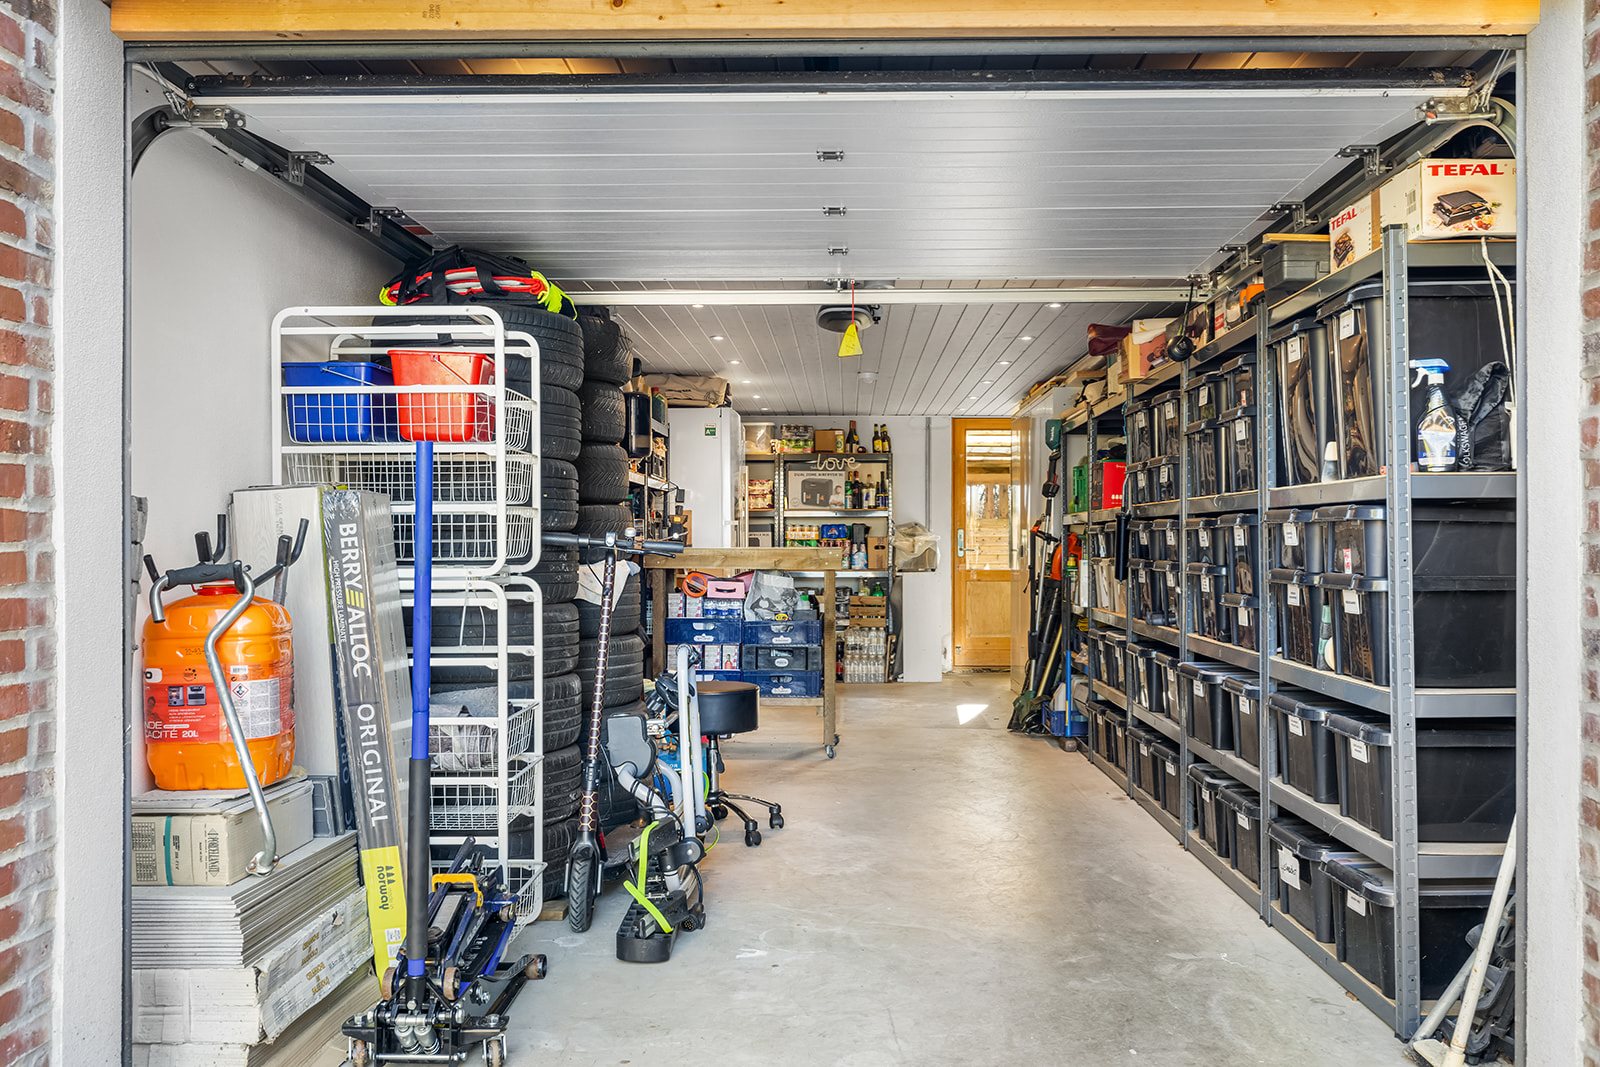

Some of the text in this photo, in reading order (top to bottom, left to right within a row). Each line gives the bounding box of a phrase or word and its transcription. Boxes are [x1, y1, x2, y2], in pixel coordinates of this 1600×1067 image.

[1427, 163, 1504, 176] TEFAL
[1331, 207, 1358, 231] TEFAL
[817, 453, 861, 470] love
[333, 560, 347, 642] HIGH PRESSURE LAMINATE
[339, 523, 372, 678] BERRY ALLOC
[182, 730, 199, 738] 20L
[357, 703, 389, 828] ORIGINAL
[377, 865, 390, 911] norway
